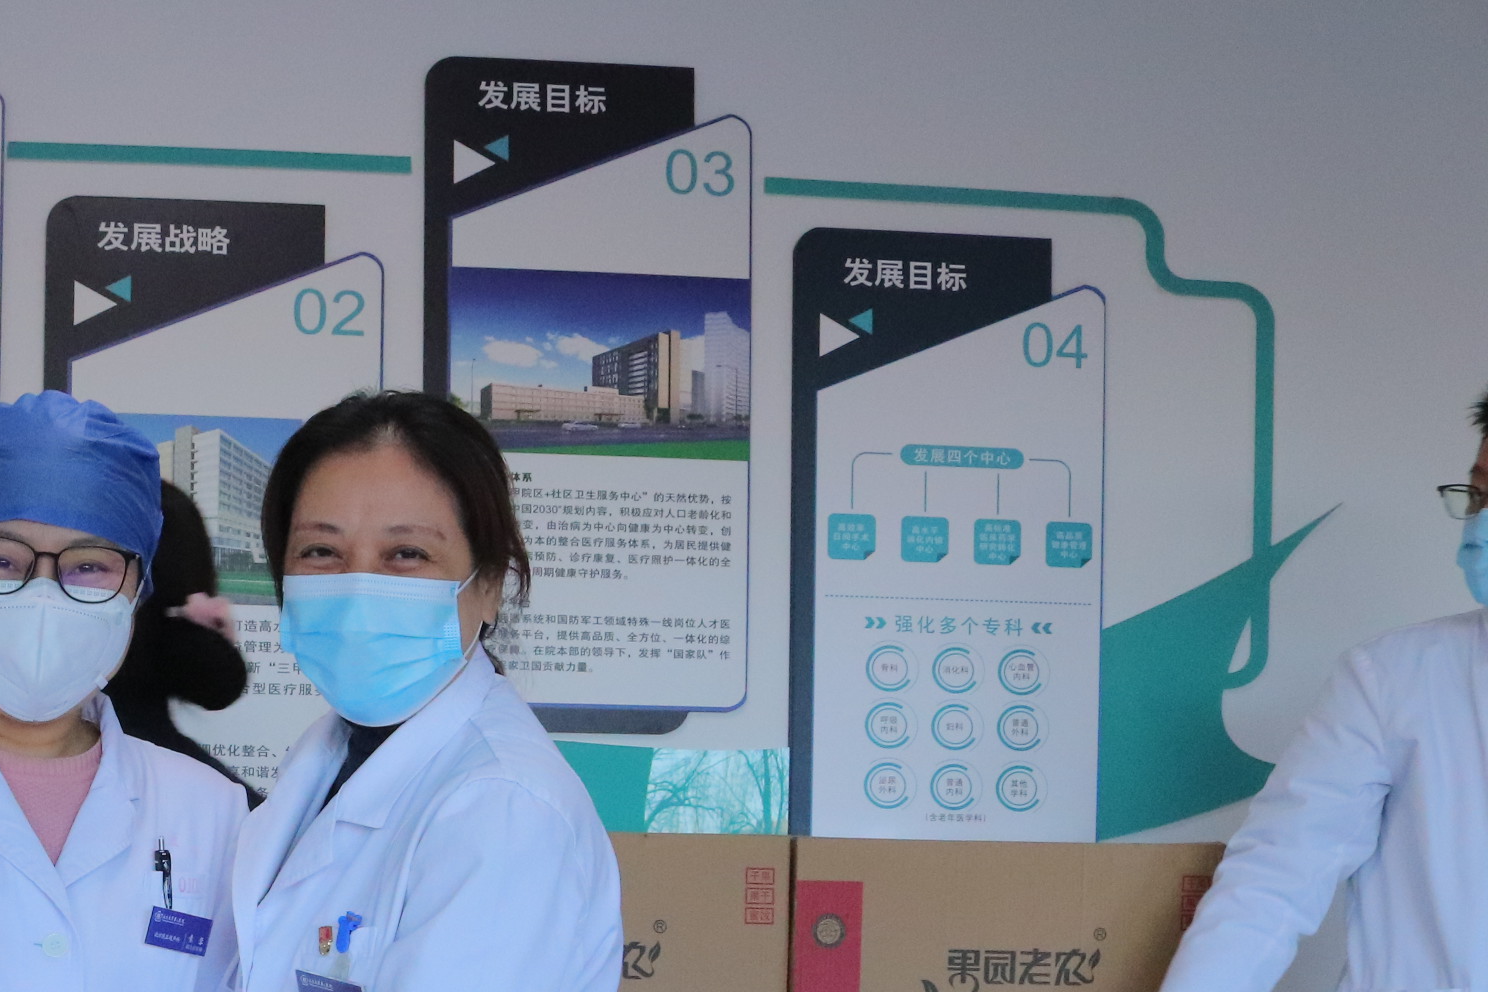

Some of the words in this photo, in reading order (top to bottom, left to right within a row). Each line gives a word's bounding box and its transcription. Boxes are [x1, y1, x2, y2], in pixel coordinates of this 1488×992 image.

[478, 80, 607, 115] 发展目标
[666, 148, 735, 197] 03
[97, 221, 230, 256] 发展战略
[843, 257, 968, 292] 发展目标
[293, 288, 366, 336] 02
[1022, 322, 1088, 369] 04
[914, 448, 1011, 466] 发展四个中心
[518, 520, 732, 537] 变，由治病为中心向健康为中心转变，创
[895, 615, 1023, 637] 强化多个专科
